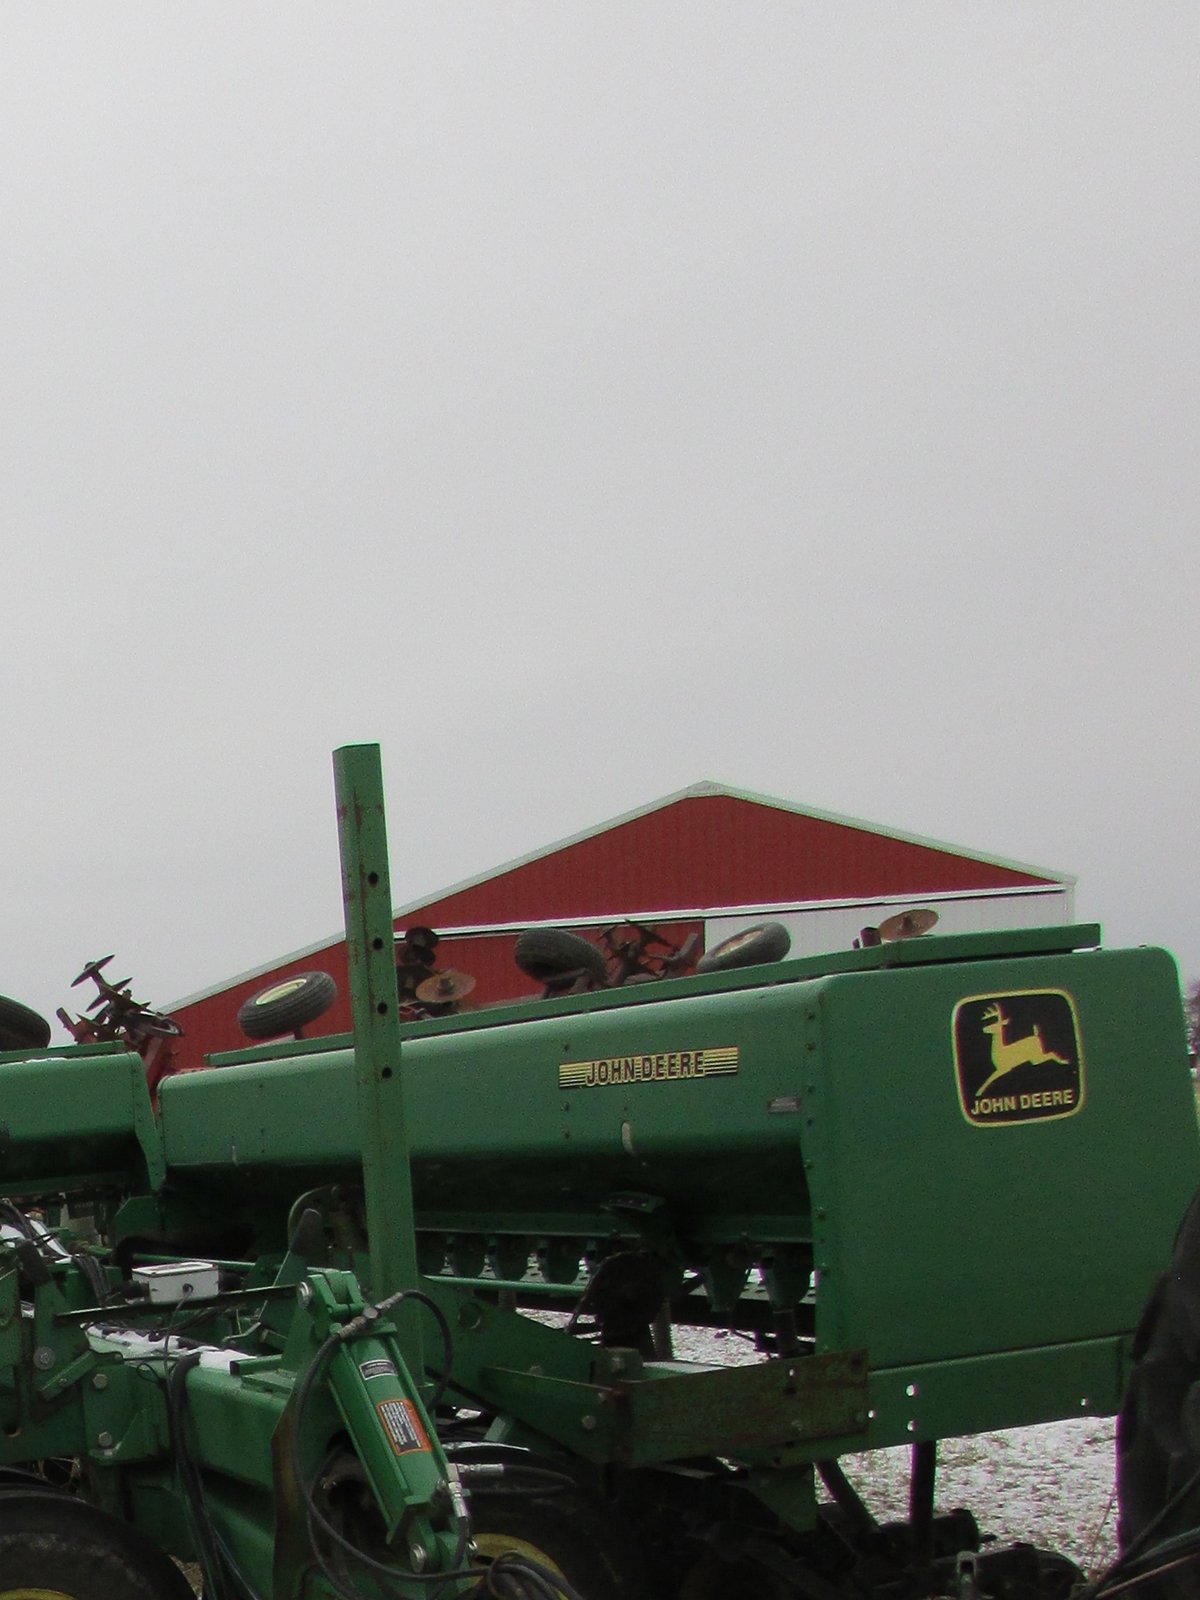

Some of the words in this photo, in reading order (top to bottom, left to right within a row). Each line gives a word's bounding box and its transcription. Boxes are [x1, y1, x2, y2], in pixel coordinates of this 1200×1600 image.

[587, 1059, 635, 1084] JOHN
[642, 1052, 704, 1079] DEERE
[971, 1096, 1015, 1115] JOHN
[1020, 1090, 1073, 1110] DEERE
